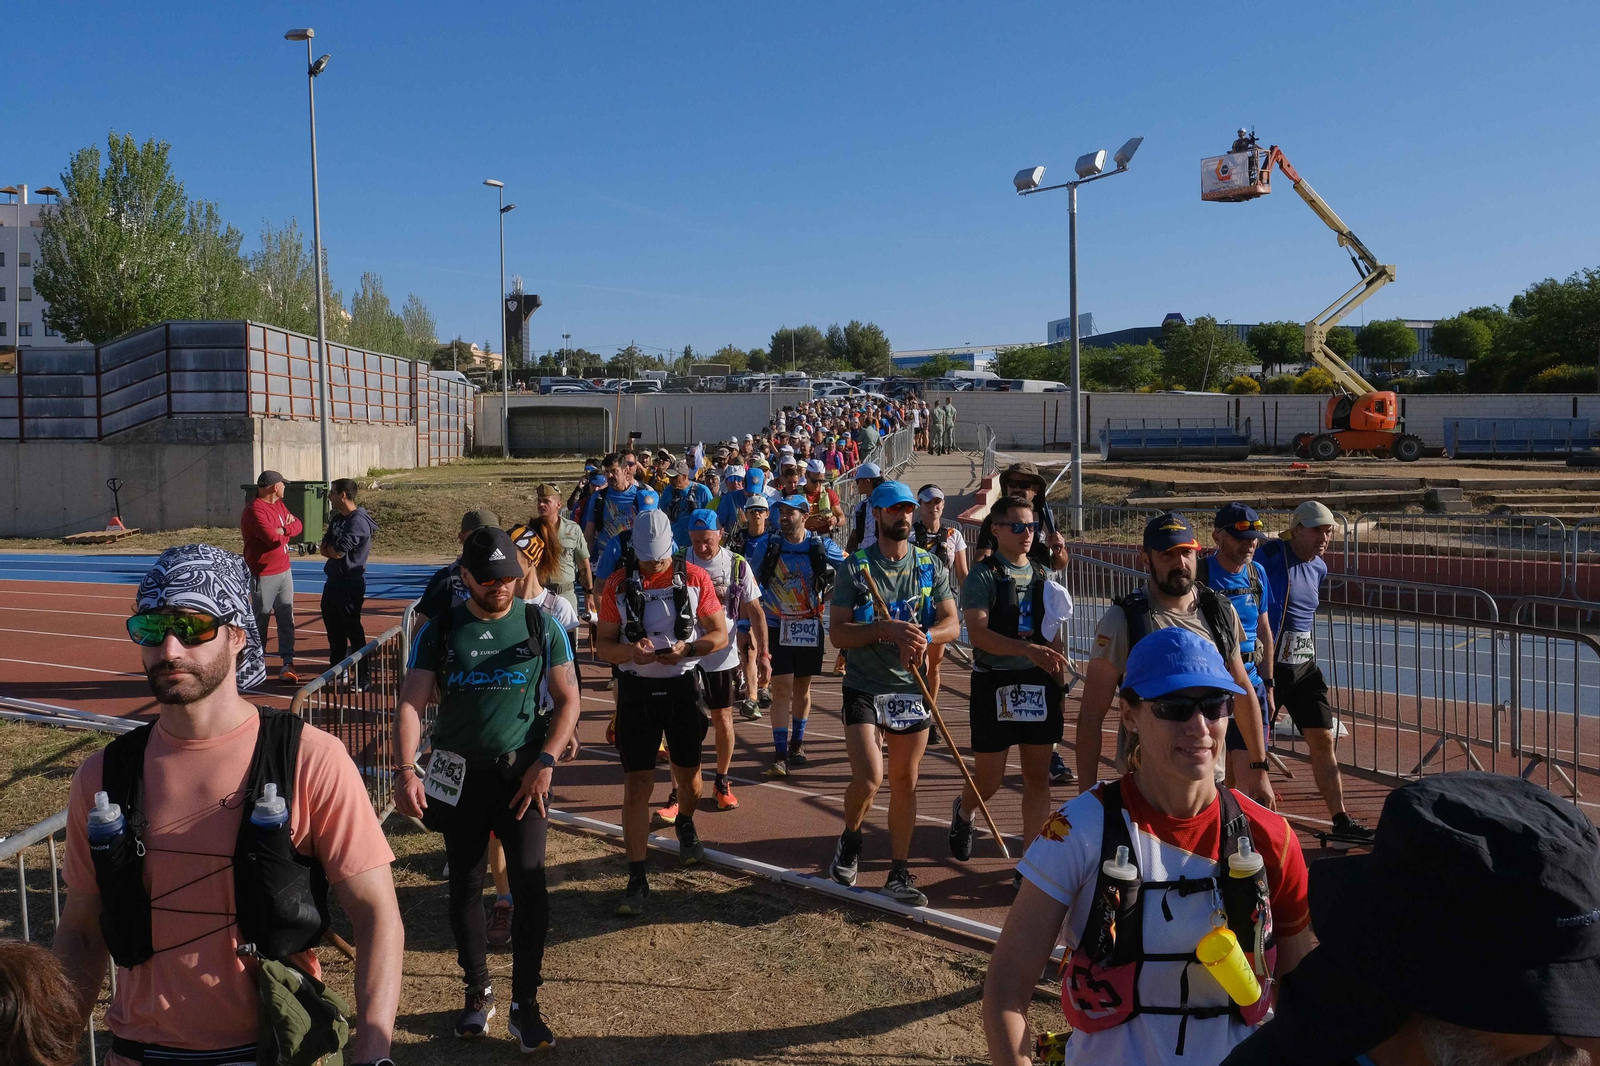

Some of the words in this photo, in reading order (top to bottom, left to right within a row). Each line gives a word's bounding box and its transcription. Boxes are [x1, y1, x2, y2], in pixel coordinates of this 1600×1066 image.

[790, 622, 816, 634] 9307
[446, 668, 527, 686] MADRID
[1010, 689, 1042, 705] 9377
[887, 699, 922, 714] 9376
